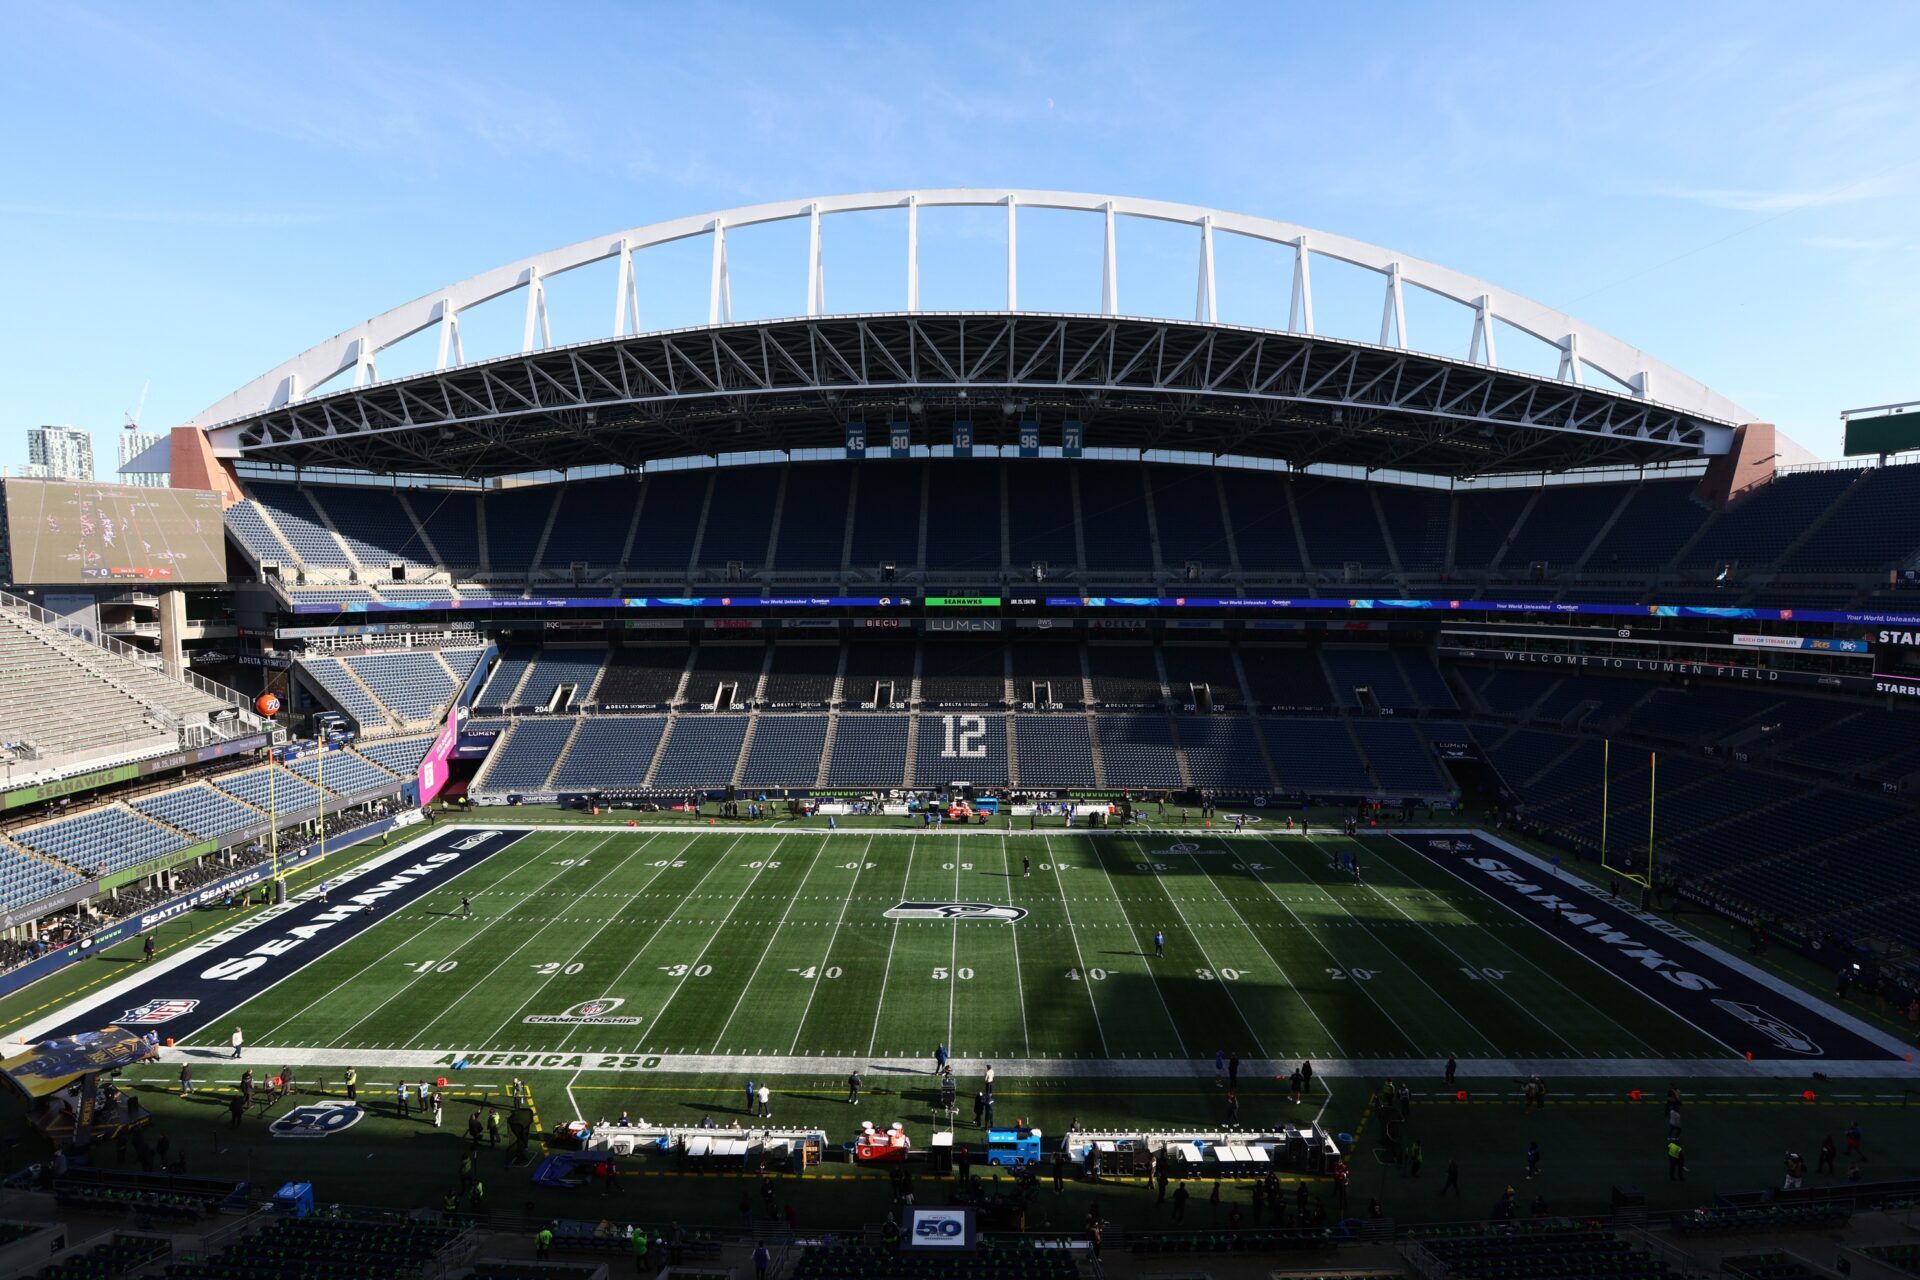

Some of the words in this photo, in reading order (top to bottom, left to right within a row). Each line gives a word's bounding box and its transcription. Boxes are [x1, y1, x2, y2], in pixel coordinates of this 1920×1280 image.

[848, 437, 864, 450] 45
[892, 436, 908, 449] 80
[956, 435, 970, 449] 12
[1021, 435, 1037, 448] 96
[1065, 435, 1079, 449] 71
[932, 620, 995, 630] LUMEN
[244, 657, 261, 665] DELTA
[1505, 652, 1588, 665] WELCOME
[1602, 659, 1622, 668] TO
[1638, 662, 1703, 674] LUMEN
[1718, 668, 1778, 680] FIELD
[941, 715, 986, 757] 12
[37, 772, 115, 799] SEAHAWKS
[135, 851, 188, 877] SEAHAWKS
[142, 895, 198, 929] SEATTLE
[200, 871, 260, 902] SEAHAWKS
[14, 904, 48, 921] COLUMBIA
[49, 898, 66, 910] BANK
[200, 852, 460, 981] SEAHAWKS
[1463, 857, 1720, 990] SEAHAWKS
[528, 1016, 638, 1024] CHAMPIONSHIP
[434, 1054, 584, 1069] AMERICA
[598, 1056, 662, 1070] 250
[273, 1106, 361, 1131] 50
[862, 1147, 872, 1157] G
[916, 1219, 962, 1237] 50
